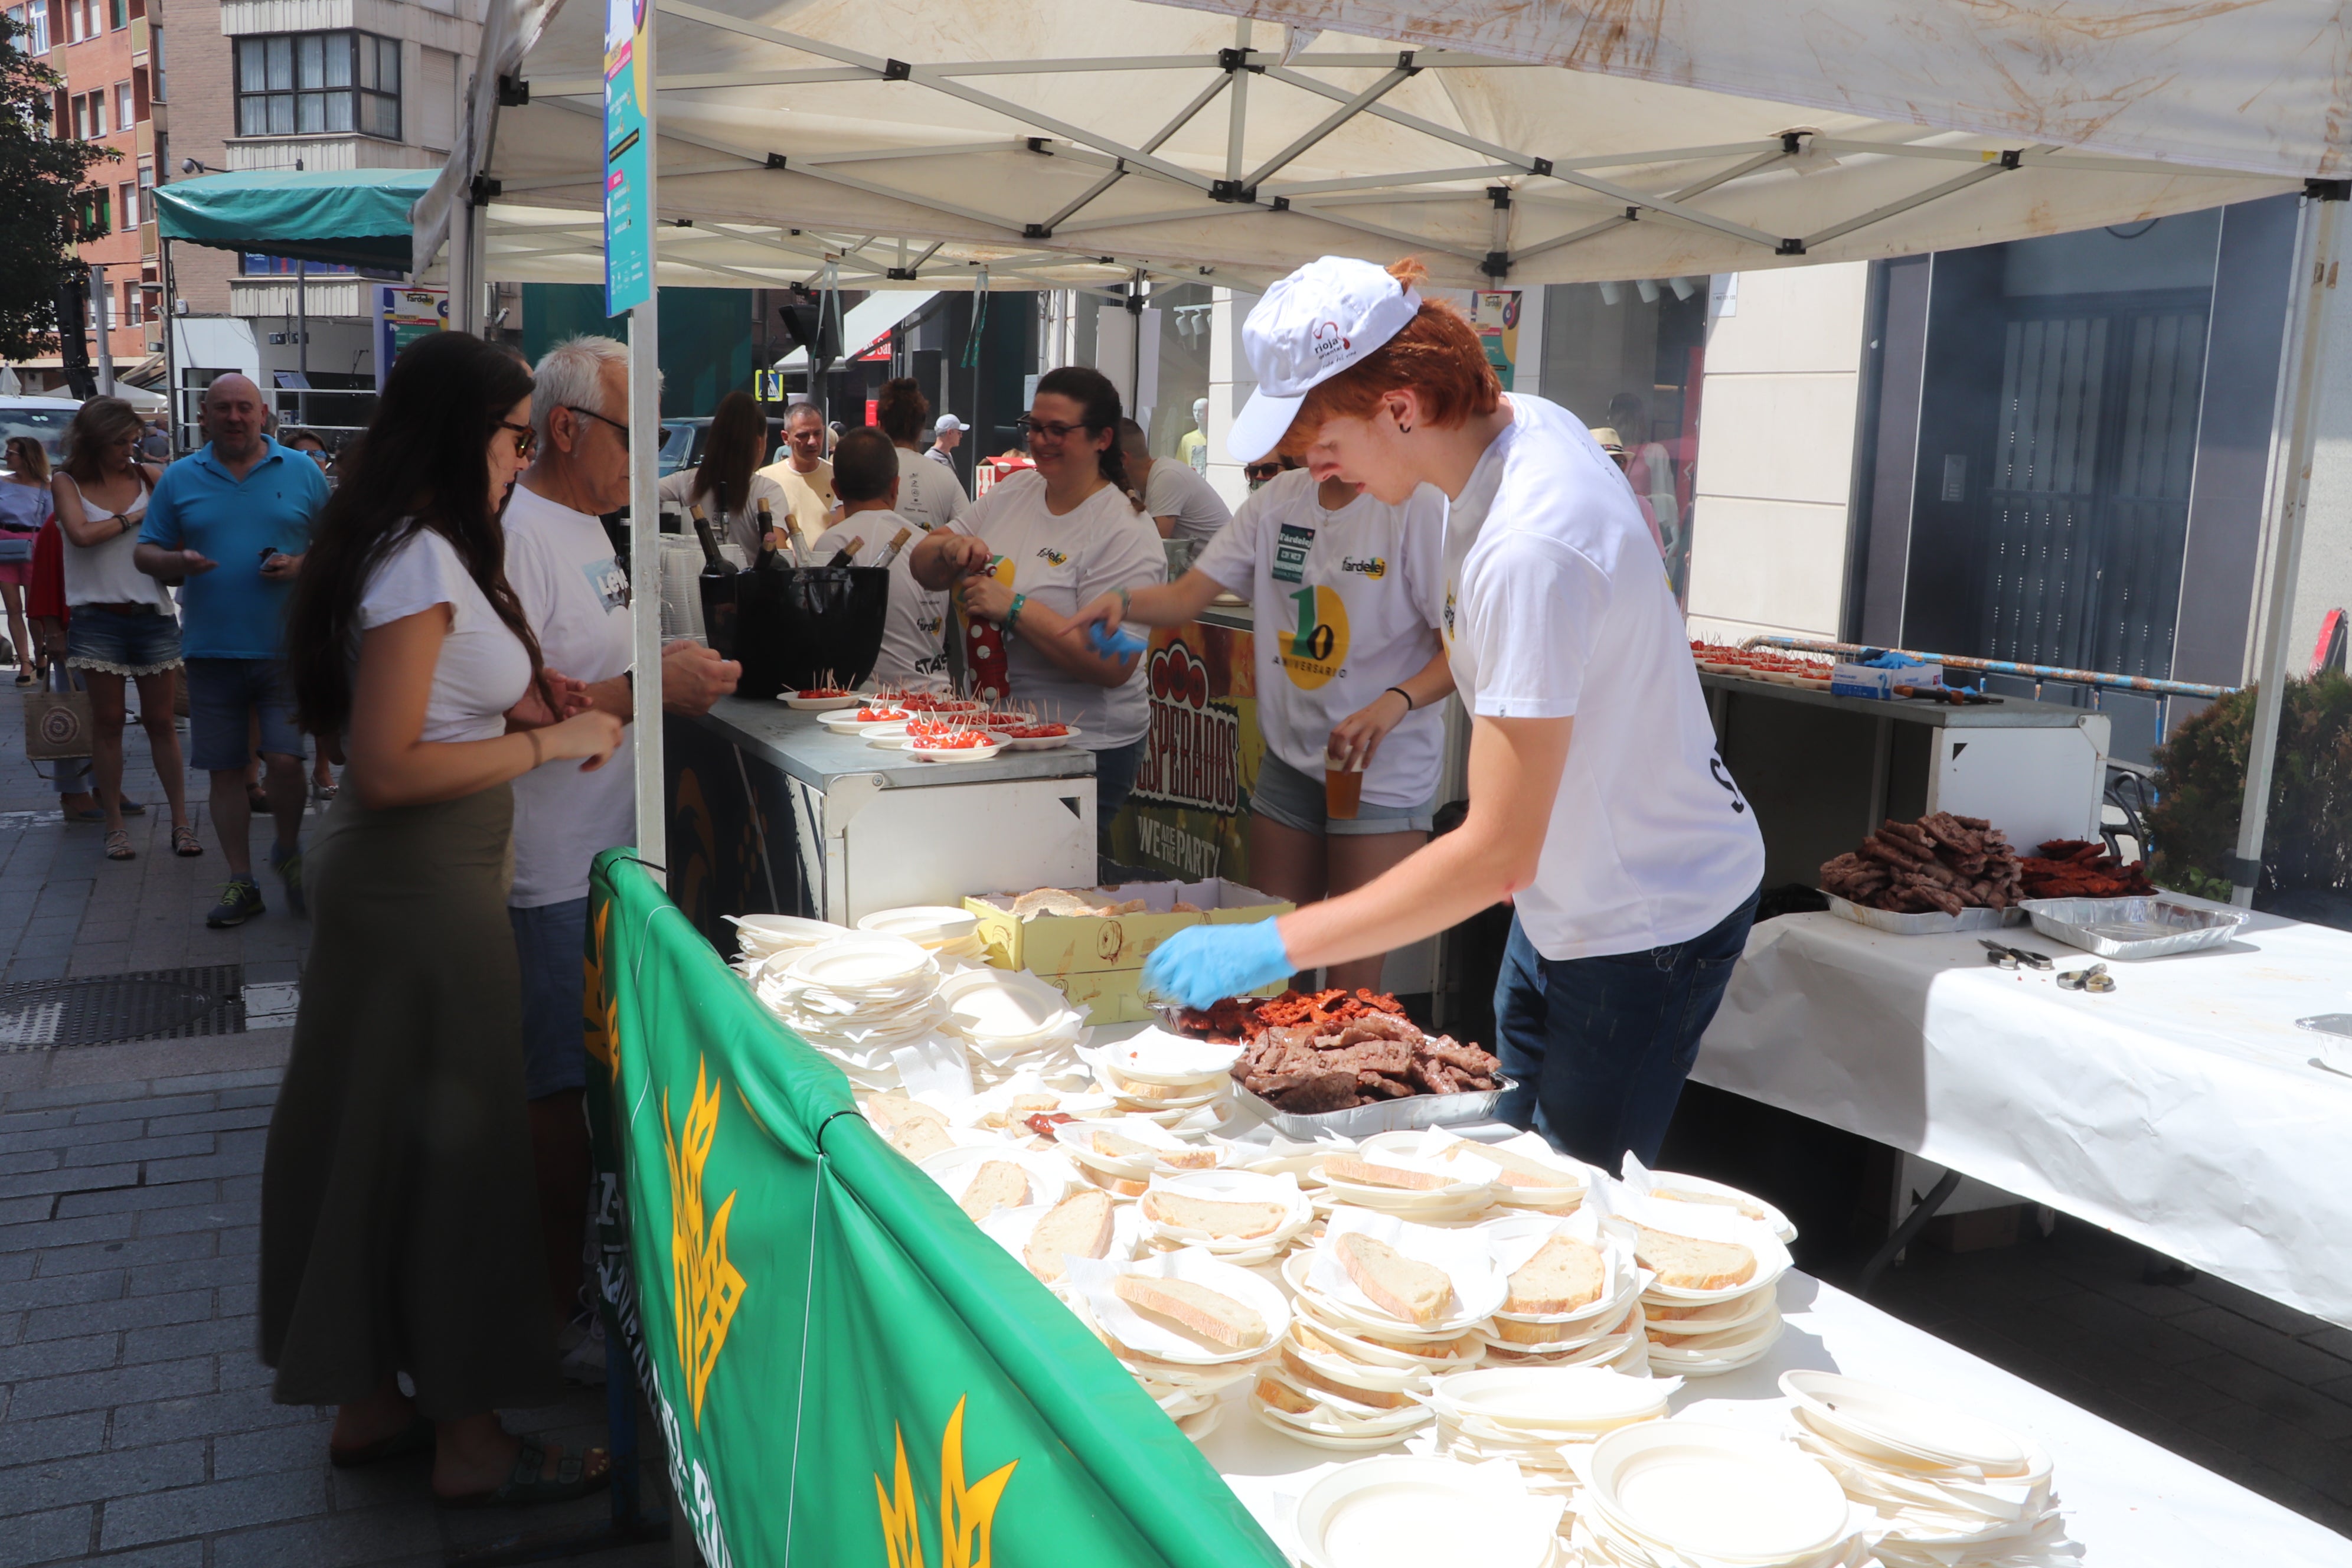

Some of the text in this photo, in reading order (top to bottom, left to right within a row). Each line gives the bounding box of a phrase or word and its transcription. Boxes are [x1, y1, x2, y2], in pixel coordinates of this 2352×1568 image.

[1315, 337, 1338, 354] rioja
[1319, 345, 1342, 360] oriental
[1272, 655, 1347, 678] ANIVERSARIO
[1138, 815, 1220, 878] WE ARE THE PARTY
